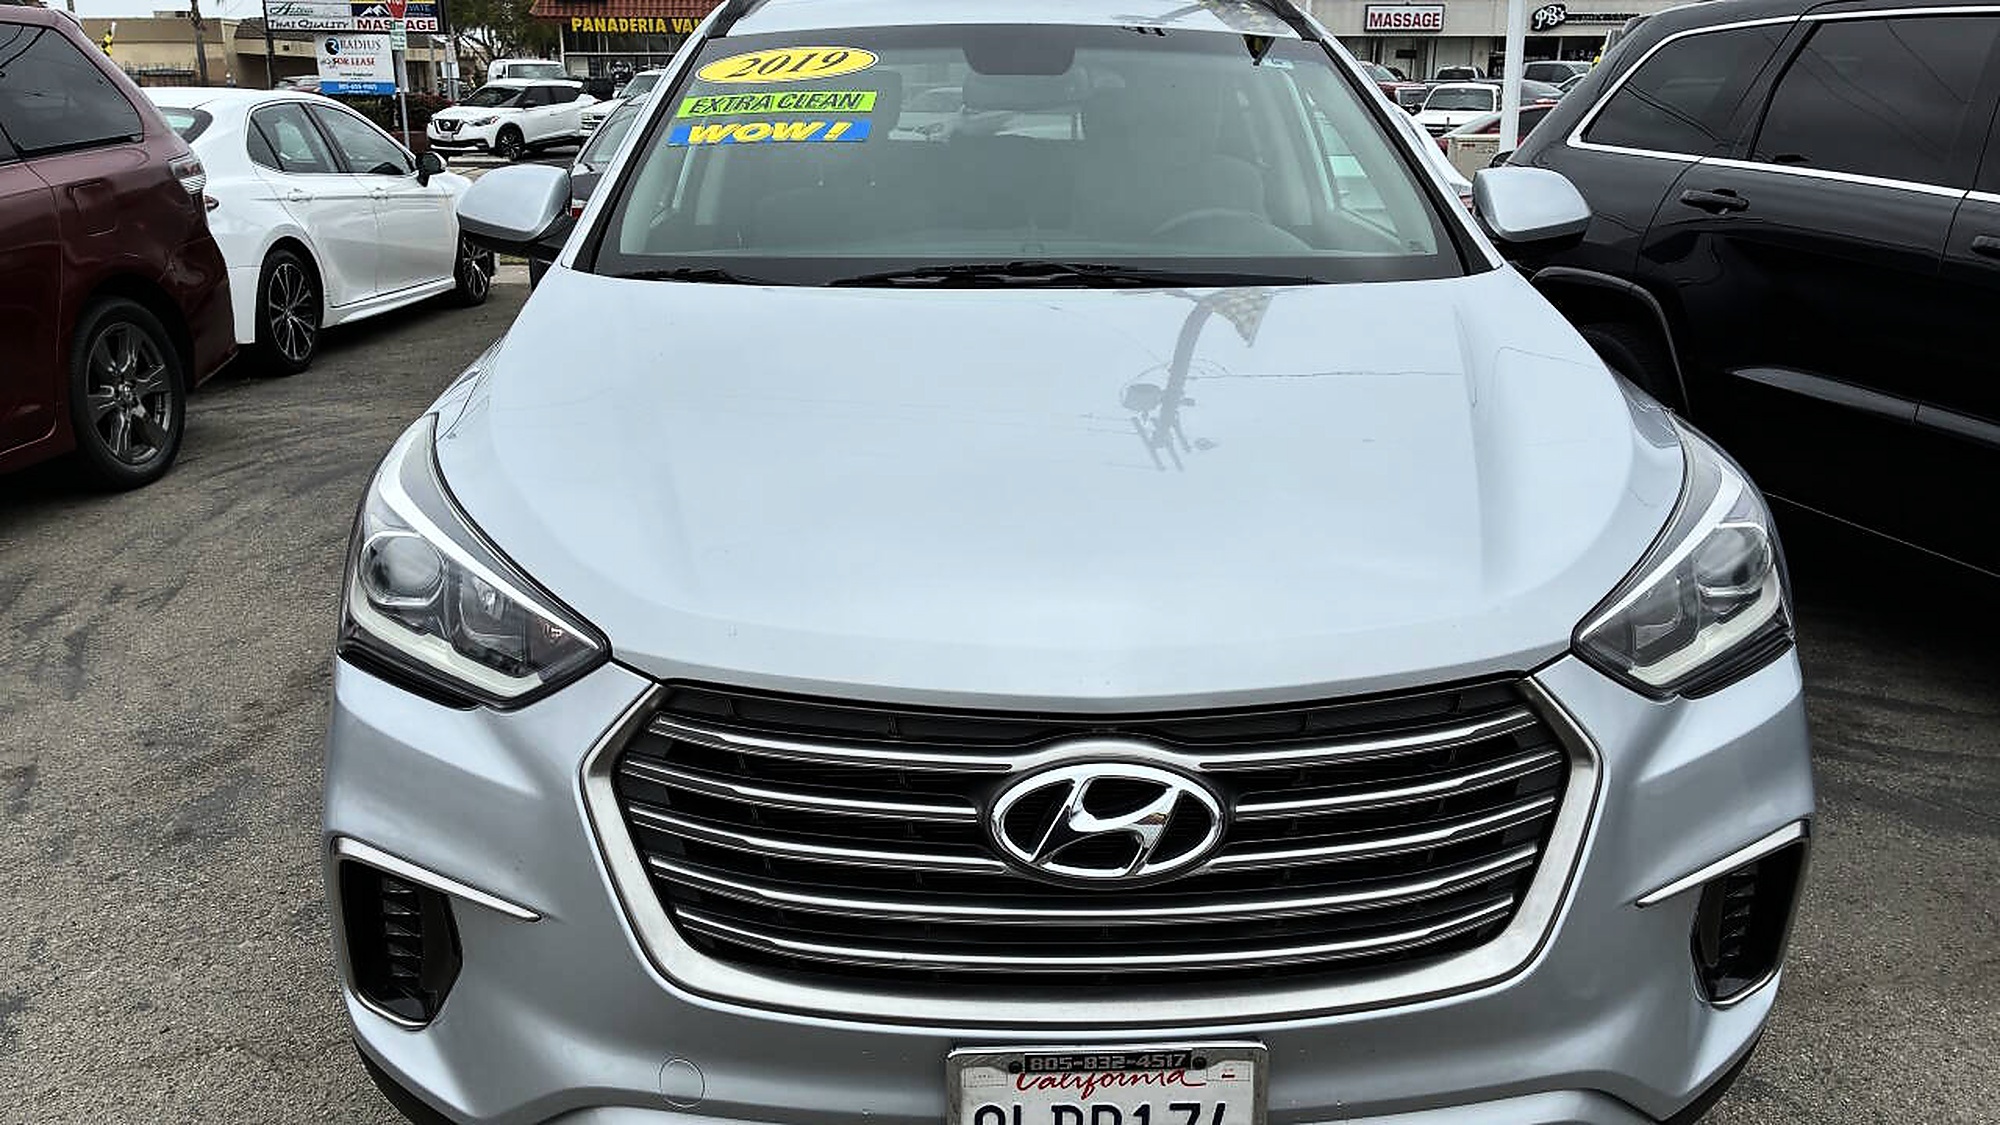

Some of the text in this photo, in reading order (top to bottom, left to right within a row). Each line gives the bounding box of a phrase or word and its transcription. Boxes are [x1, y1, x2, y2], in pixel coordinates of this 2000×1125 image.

[356, 19, 437, 31] MASAGE
[571, 17, 667, 33] PANADERIA
[1369, 12, 1441, 28] MASSAGE
[350, 57, 376, 66] LEASE
[725, 51, 849, 78] 2019
[689, 93, 863, 114] EXTRA CLEAN
[1030, 1053, 1186, 1071] 805-832-4517
[1016, 1069, 1207, 1100] California
